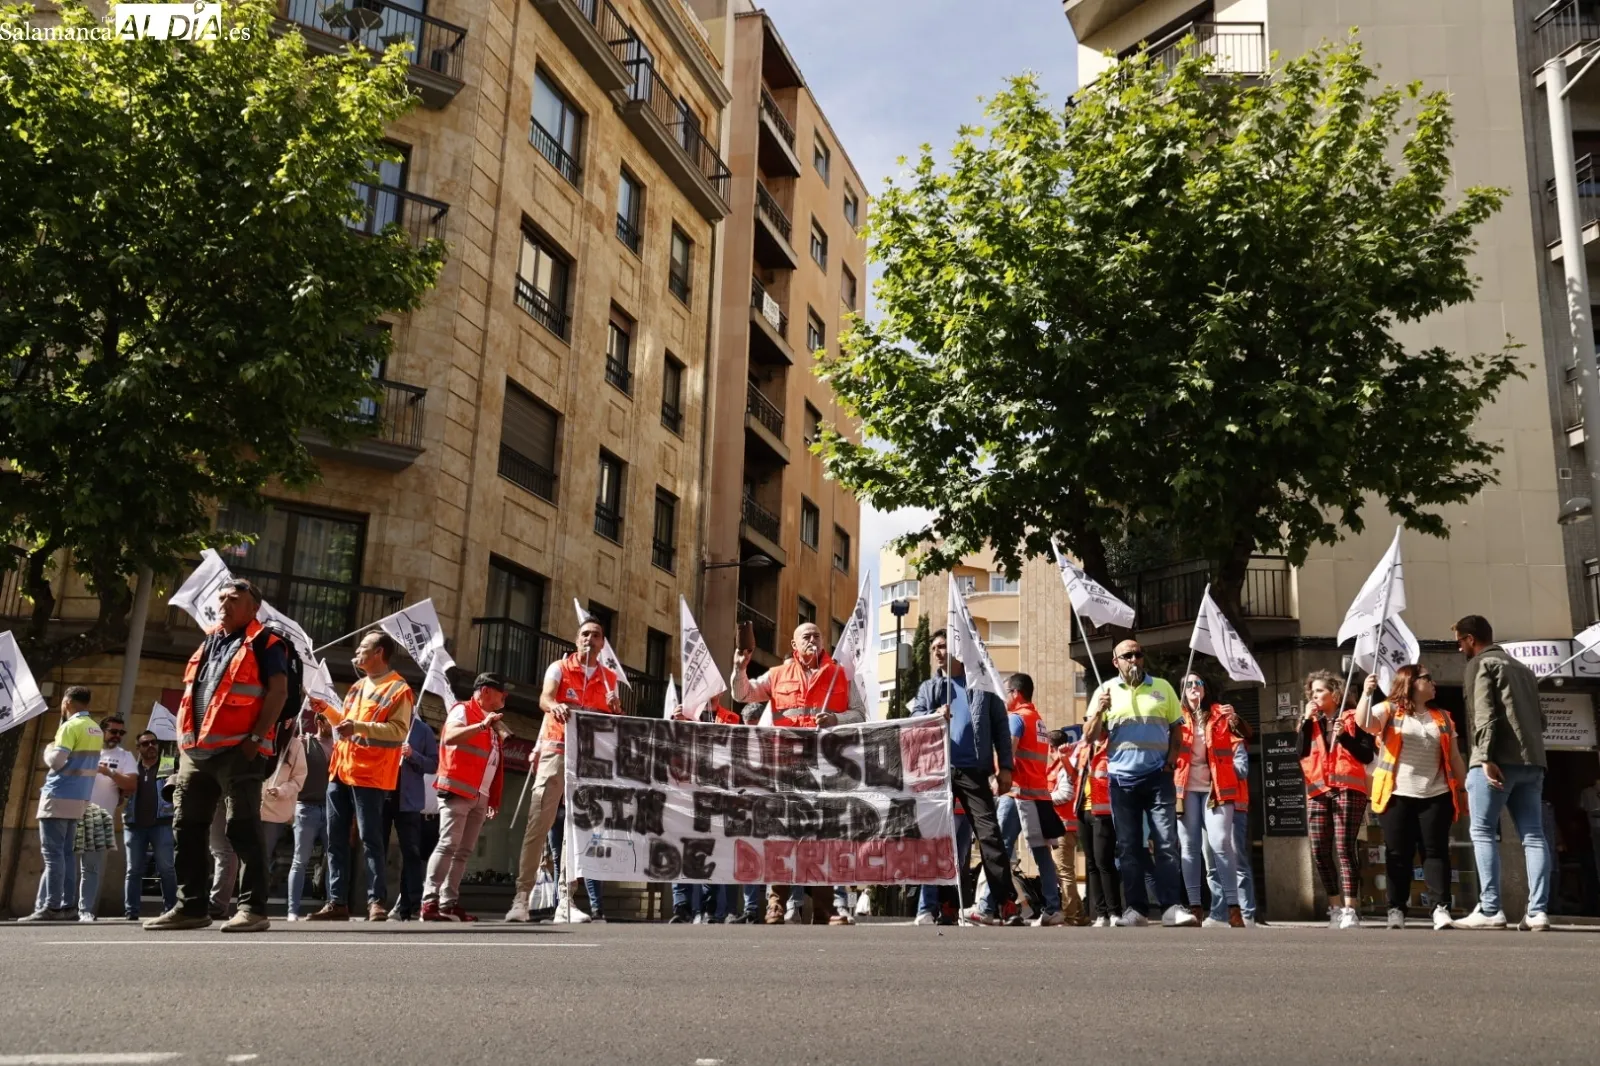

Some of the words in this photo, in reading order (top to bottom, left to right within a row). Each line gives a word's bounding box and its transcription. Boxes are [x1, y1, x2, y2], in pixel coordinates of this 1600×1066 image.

[576, 713, 904, 793] CONCURSO
[572, 784, 667, 837] SIN
[643, 837, 717, 882] DE
[733, 836, 958, 884] DERECHOS
